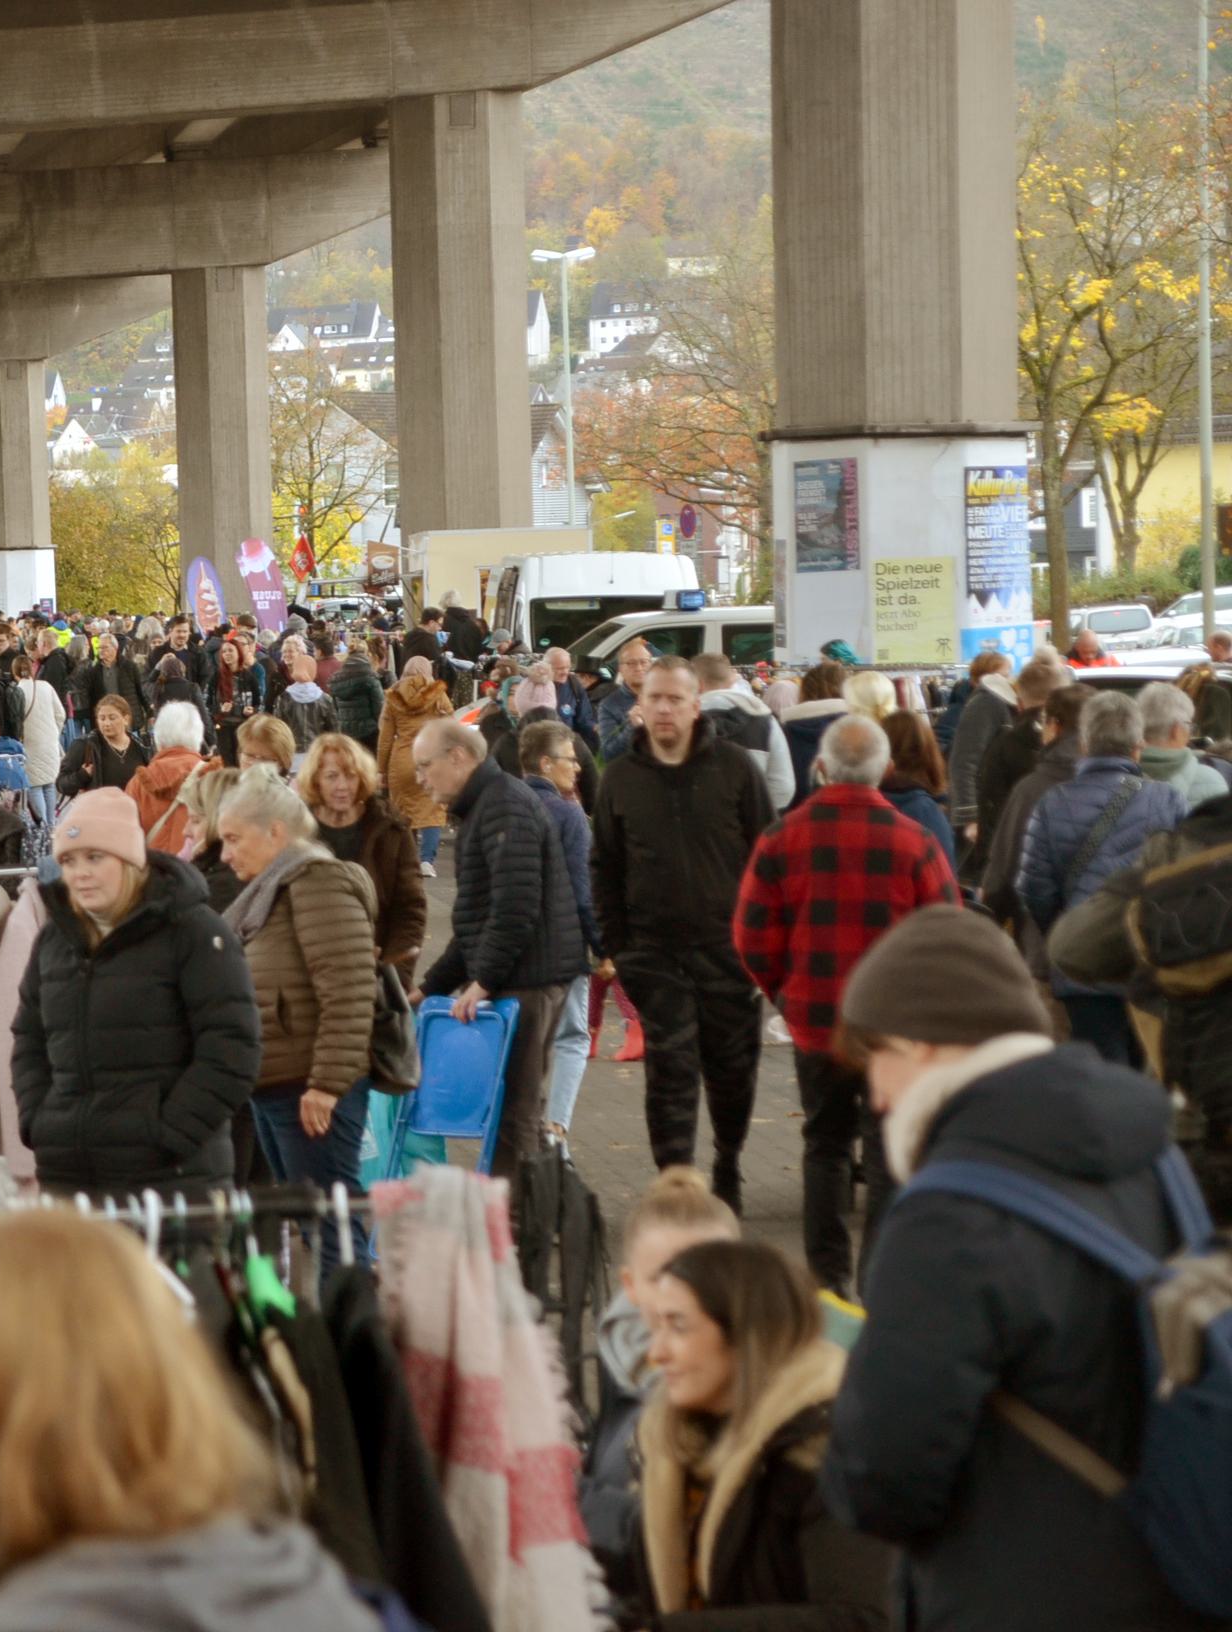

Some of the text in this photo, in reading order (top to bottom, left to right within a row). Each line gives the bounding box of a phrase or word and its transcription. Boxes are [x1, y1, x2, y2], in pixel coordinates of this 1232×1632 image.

[968, 525, 1006, 539] MEUTE
[875, 562, 943, 575] Die neue
[875, 576, 941, 593] Spielzeit
[875, 593, 921, 606] ist da.
